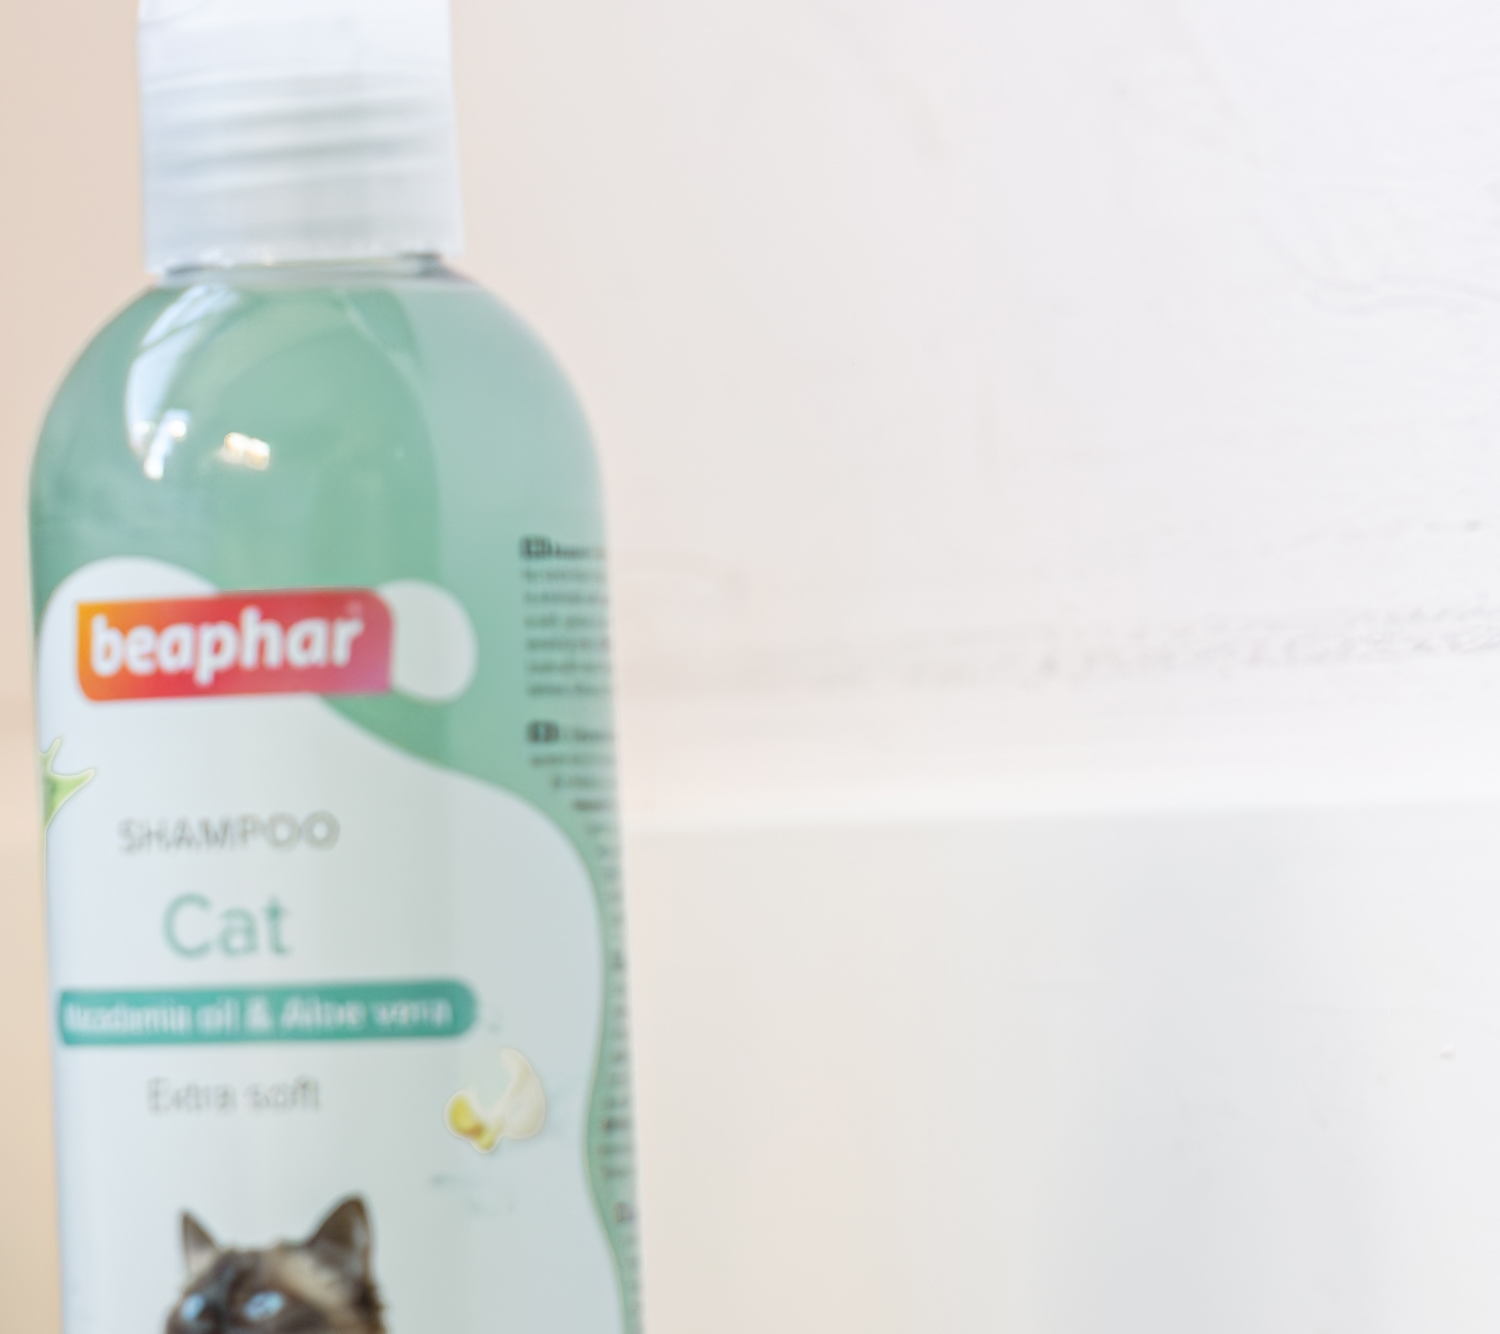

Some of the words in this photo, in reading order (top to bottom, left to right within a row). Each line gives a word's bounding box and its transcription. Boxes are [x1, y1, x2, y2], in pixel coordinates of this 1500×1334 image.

[91, 605, 364, 688] beaphar
[117, 810, 340, 855] SHAMPOO
[161, 892, 293, 960] Cat
[244, 994, 274, 1032] &
[146, 1076, 237, 1114] Extra
